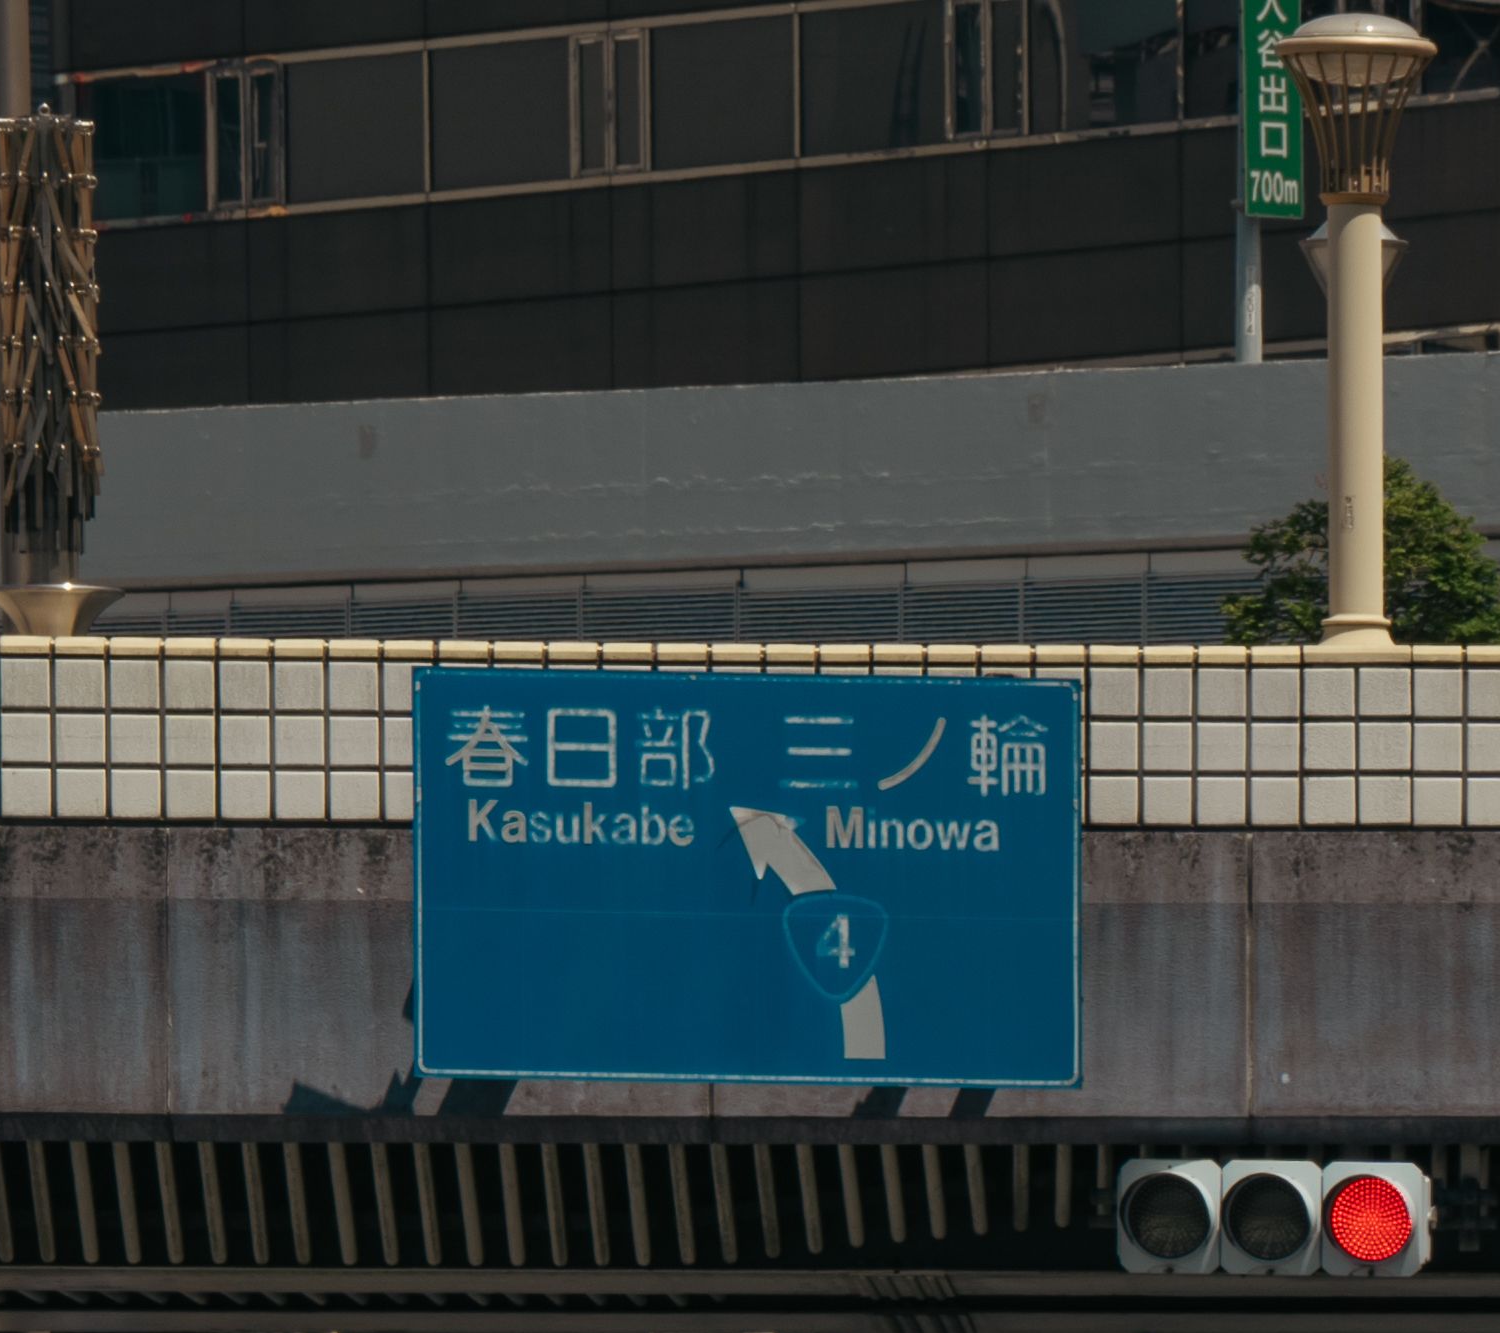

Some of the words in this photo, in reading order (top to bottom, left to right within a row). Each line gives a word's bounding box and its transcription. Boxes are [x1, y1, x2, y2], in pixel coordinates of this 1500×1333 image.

[1250, 170, 1299, 206] 700m
[445, 705, 715, 790] 春日部
[779, 713, 1048, 797] 三ノ輪
[467, 798, 696, 848] Kasukabe
[826, 804, 1001, 853] Minowa
[817, 914, 856, 970] 4
